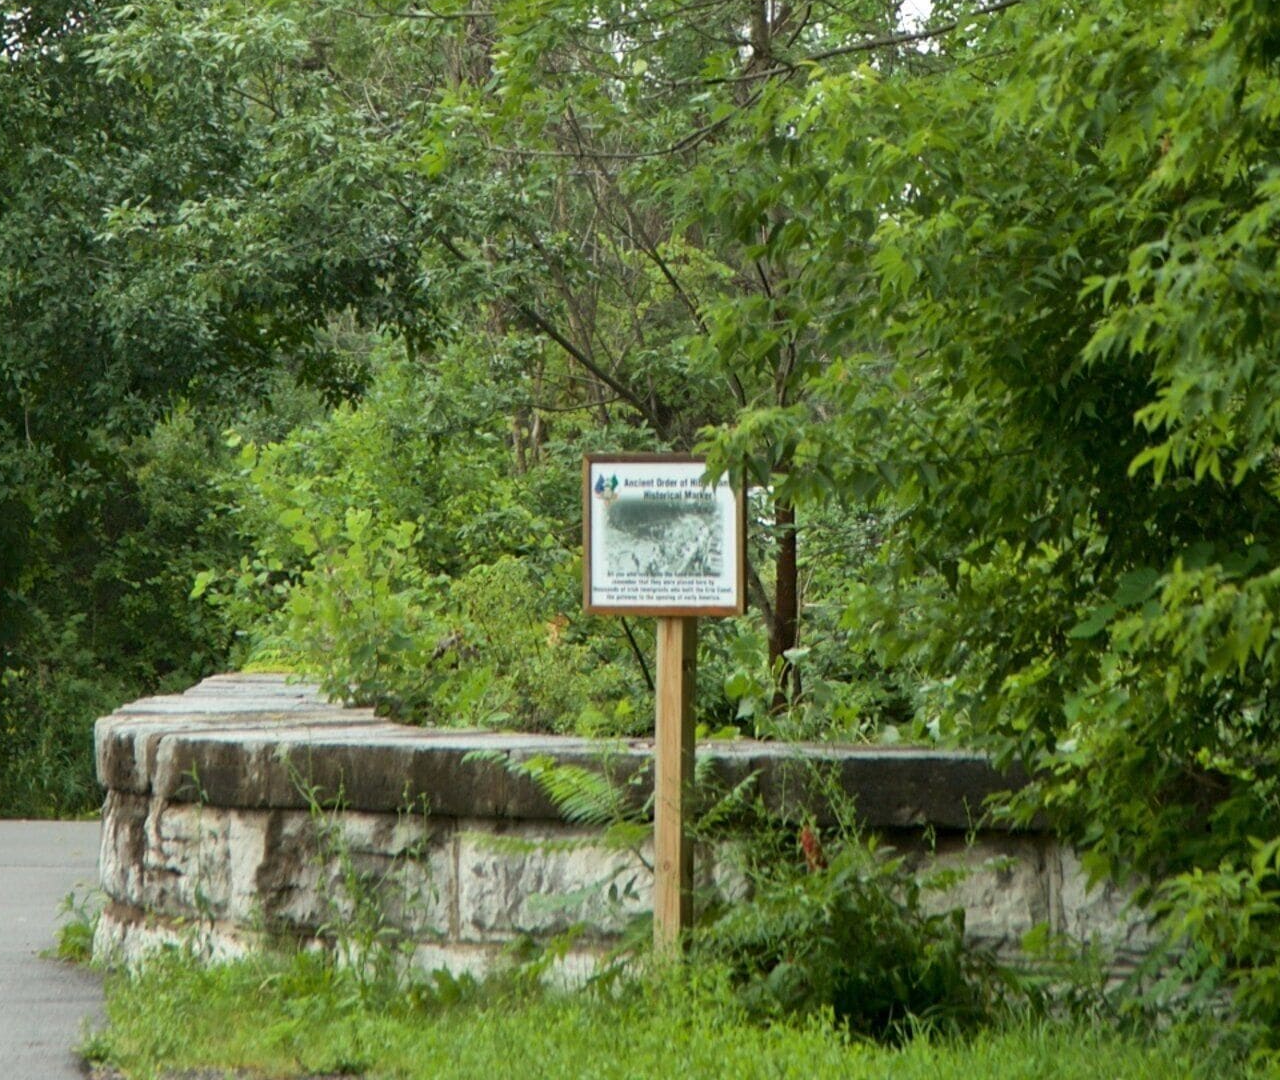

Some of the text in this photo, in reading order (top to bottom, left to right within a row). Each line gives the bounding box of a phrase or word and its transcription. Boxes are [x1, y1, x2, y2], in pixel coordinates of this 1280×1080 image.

[624, 478, 654, 487] Ancient
[656, 478, 677, 487] Order
[680, 478, 688, 487] of
[644, 490, 712, 500] Historical Marker
